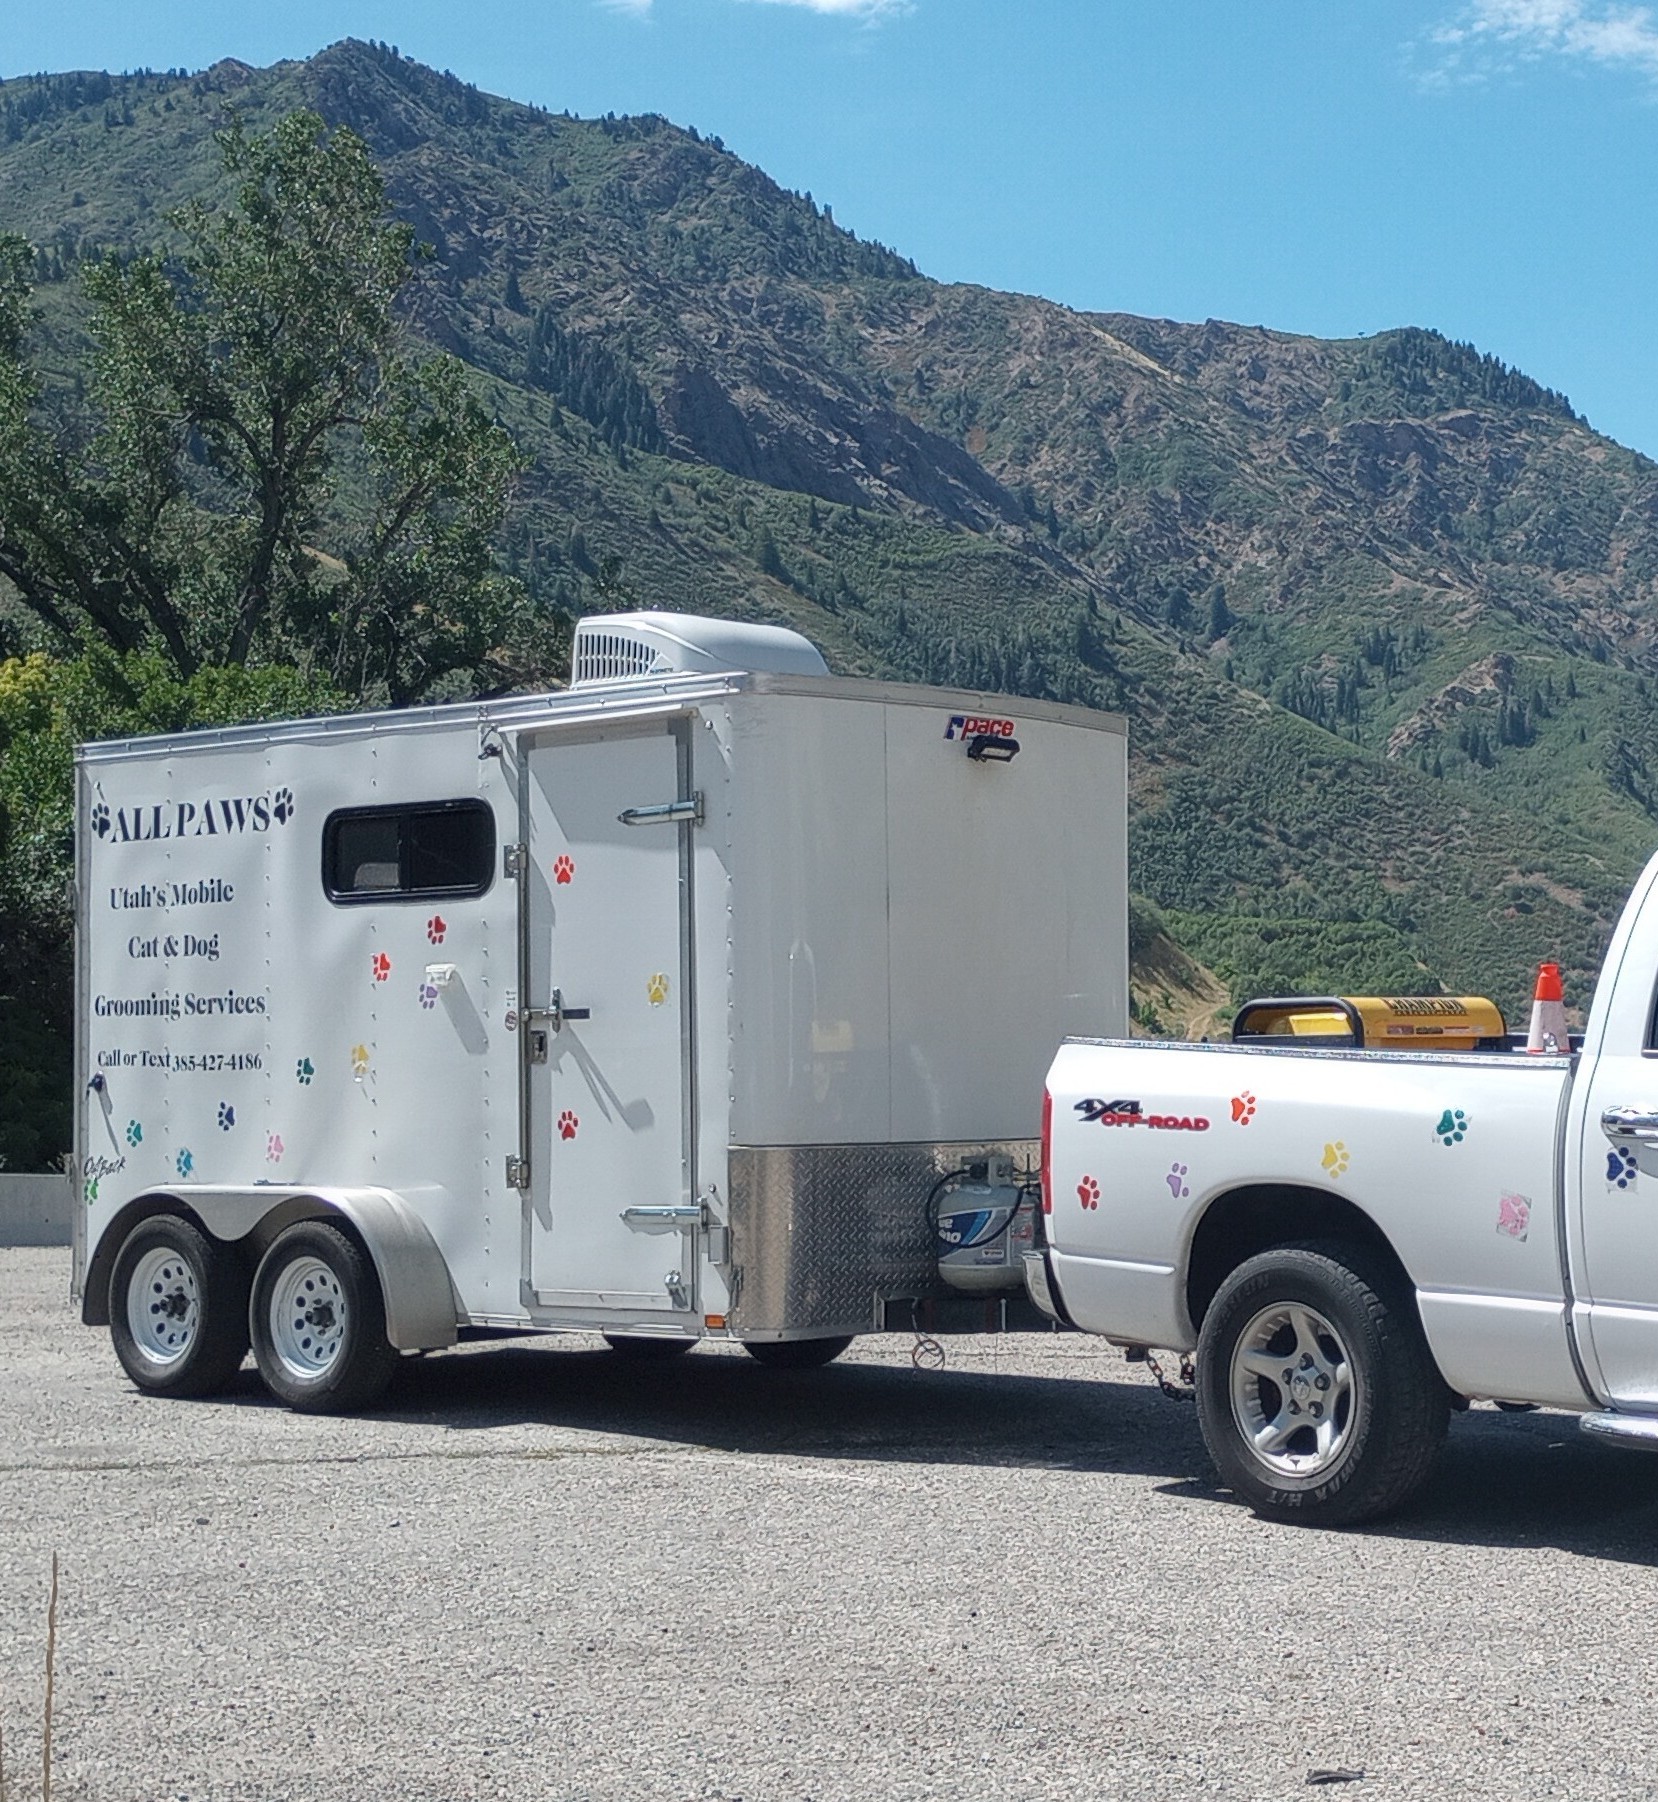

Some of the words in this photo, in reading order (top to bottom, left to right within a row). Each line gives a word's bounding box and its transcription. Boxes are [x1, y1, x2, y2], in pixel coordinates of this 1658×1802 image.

[960, 716, 1015, 741] pace
[109, 805, 172, 844] ALL
[175, 795, 271, 837] PAWS
[110, 884, 167, 910] Utah's
[170, 878, 234, 907] Mobile
[128, 935, 159, 959] Cat
[163, 934, 179, 958] &
[183, 933, 220, 962] Dog
[94, 992, 181, 1021] Grooming
[184, 989, 266, 1016] Services
[97, 1049, 121, 1067] Call
[123, 1052, 137, 1066] or
[139, 1050, 171, 1068] Text
[172, 1053, 262, 1072] 385-427-4186
[1101, 1113, 1211, 1131] OFF-ROAD
